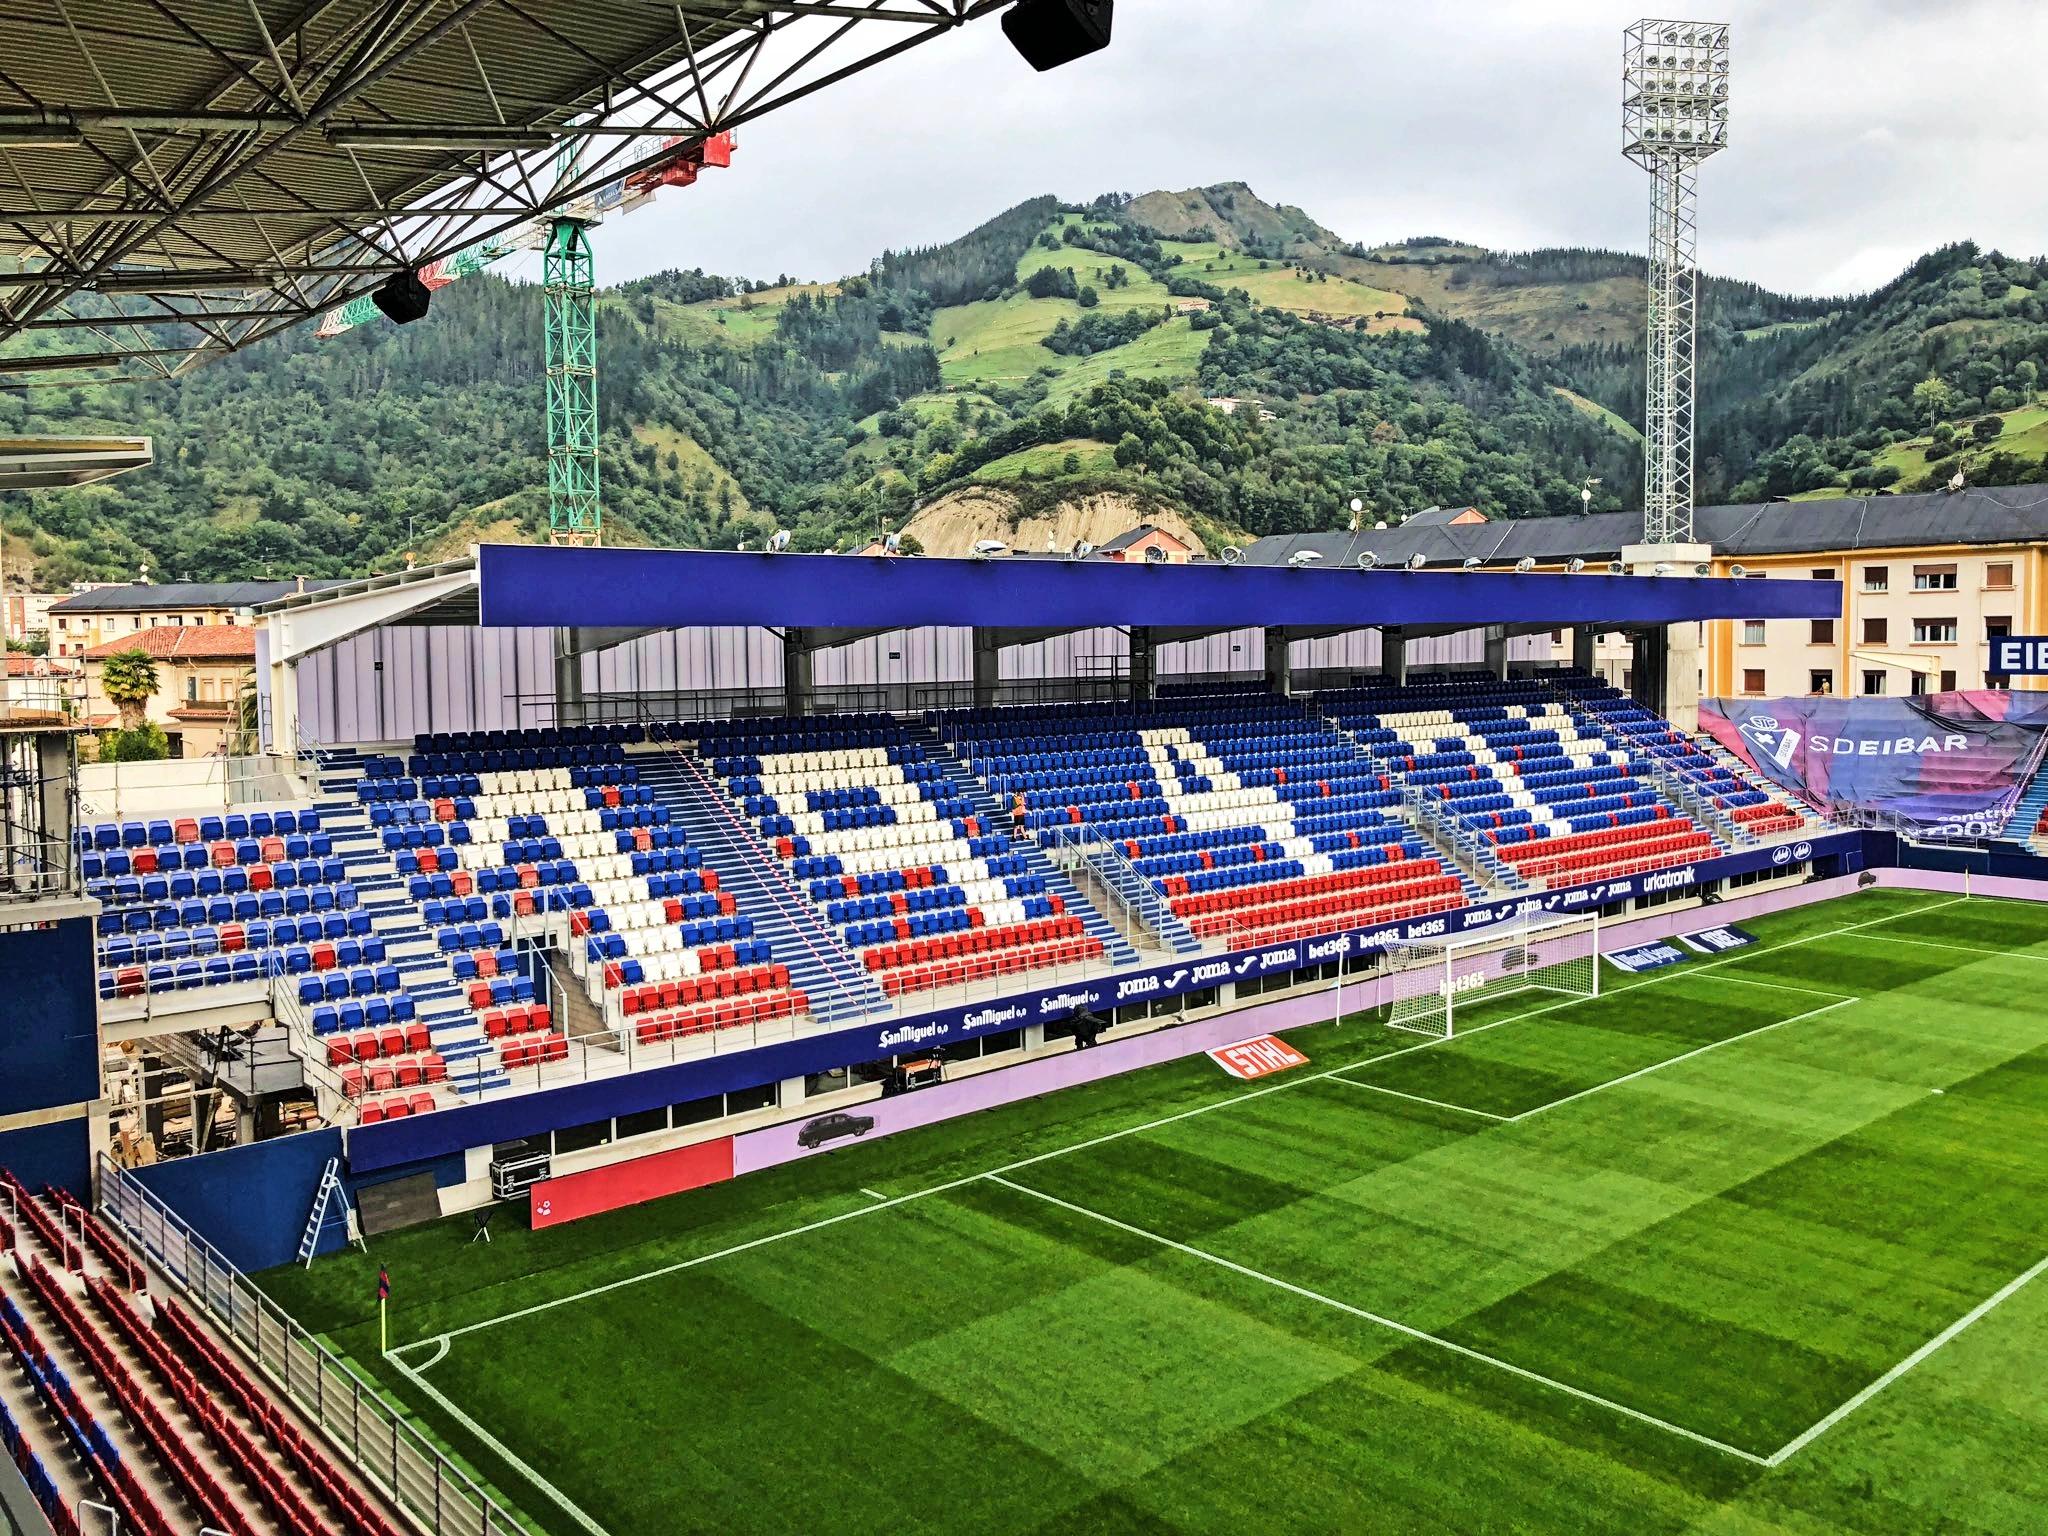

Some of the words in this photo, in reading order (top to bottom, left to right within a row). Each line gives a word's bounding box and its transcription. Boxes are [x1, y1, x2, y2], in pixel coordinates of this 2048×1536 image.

[1308, 940, 1351, 960] bet365
[1359, 928, 1400, 949] bet365
[1407, 918, 1445, 939] bet365
[1225, 1040, 1301, 1076] STIHL
